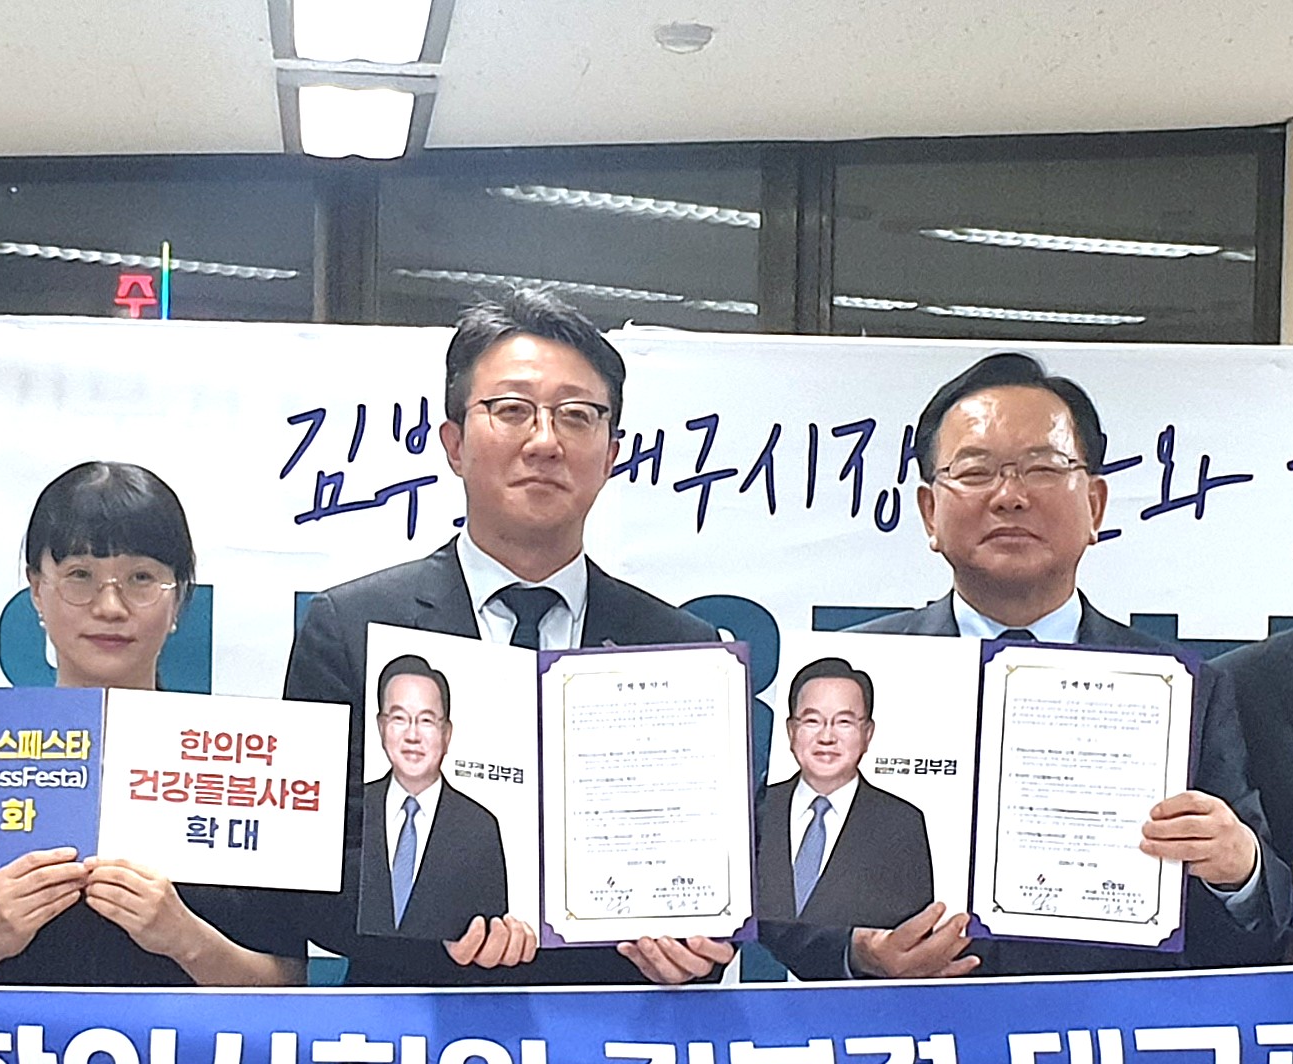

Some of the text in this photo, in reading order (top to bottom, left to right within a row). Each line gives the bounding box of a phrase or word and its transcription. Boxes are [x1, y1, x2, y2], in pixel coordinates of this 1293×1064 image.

[277, 393, 469, 545] 김부
[180, 728, 278, 767] 한의약
[913, 758, 958, 776] 김부겸
[129, 769, 321, 812] 건강돌봄사업
